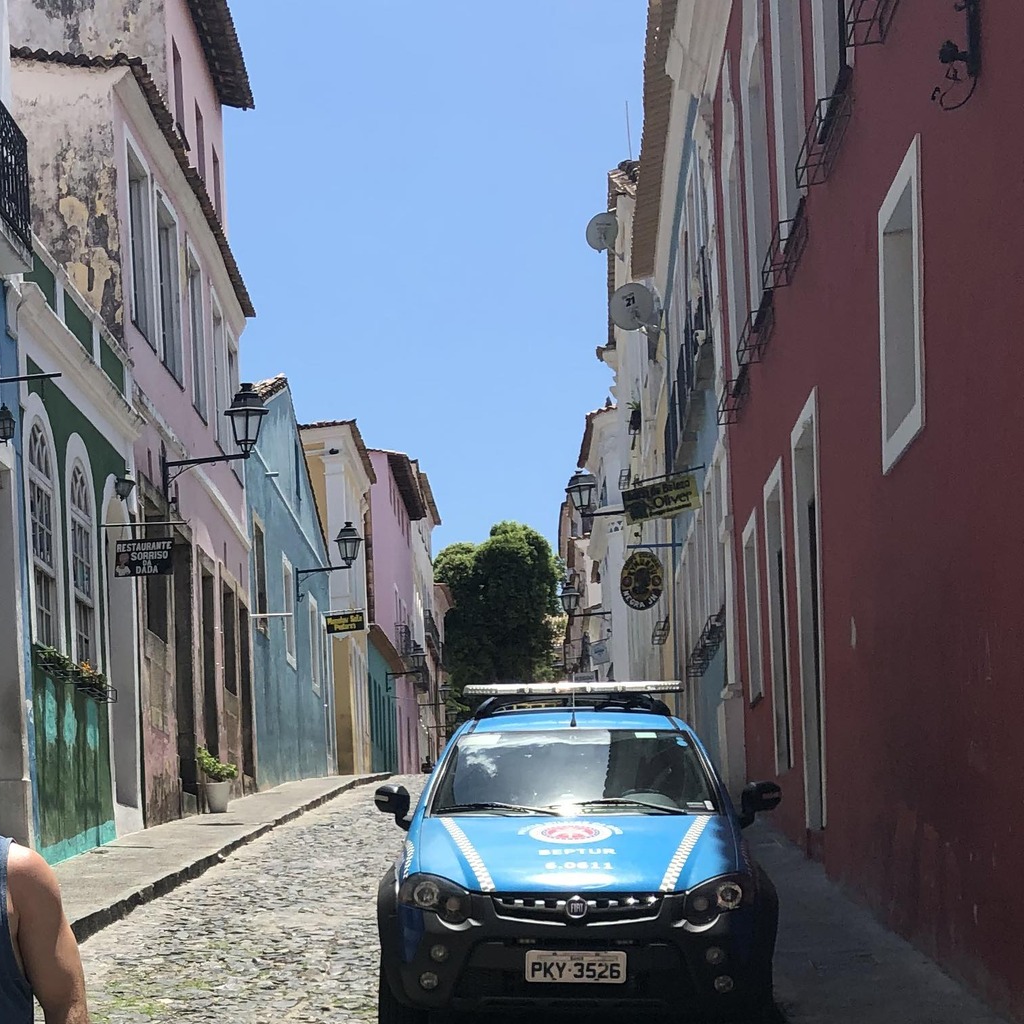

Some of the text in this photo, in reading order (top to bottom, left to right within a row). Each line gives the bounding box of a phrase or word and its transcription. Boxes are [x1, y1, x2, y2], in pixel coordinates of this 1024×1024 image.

[625, 295, 636, 307] 21
[116, 541, 173, 553] RESTAURANTE
[130, 550, 169, 561] SORRISO
[538, 847, 617, 856] SEPTUR
[544, 861, 614, 870] 6.0611
[570, 902, 584, 913] FIAT
